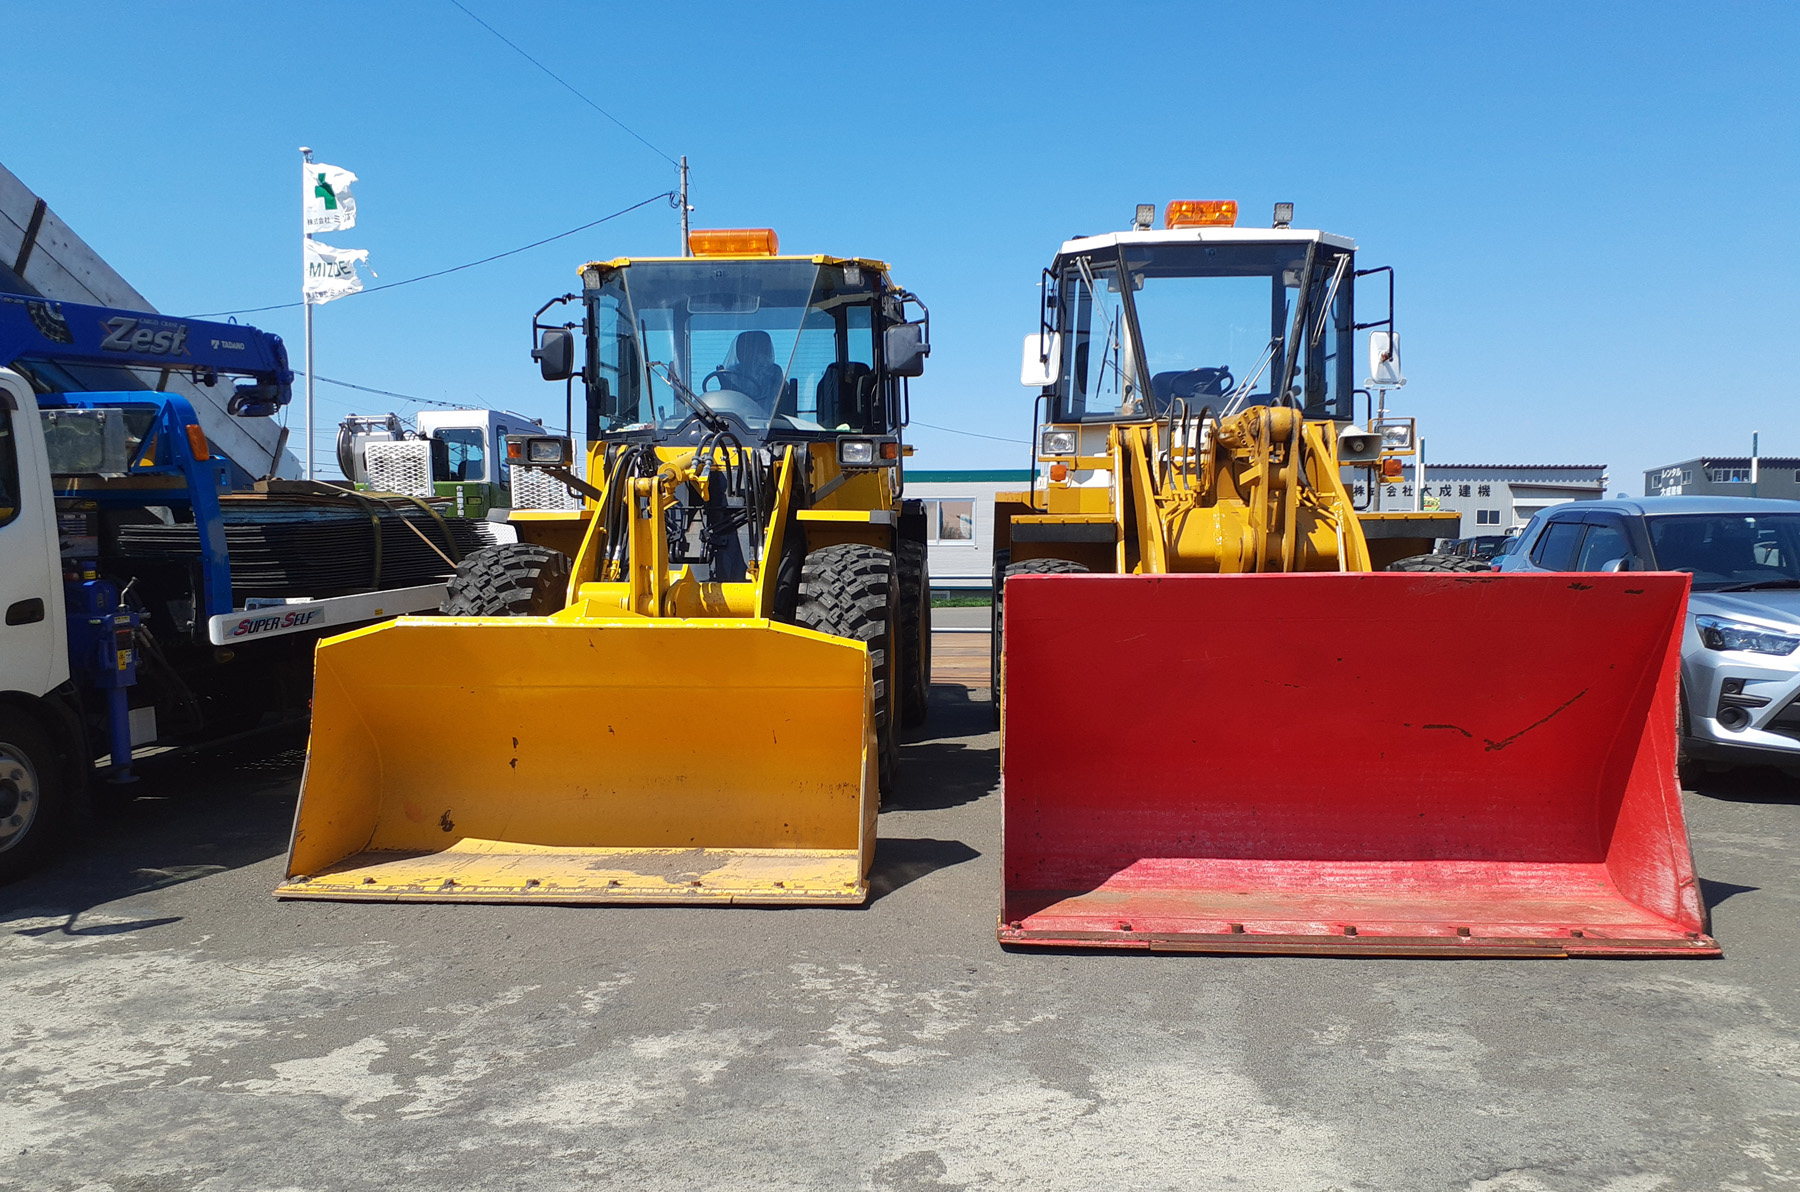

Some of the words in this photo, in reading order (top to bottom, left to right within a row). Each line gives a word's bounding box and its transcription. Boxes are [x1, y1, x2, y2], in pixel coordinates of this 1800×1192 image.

[309, 260, 352, 278] MIZOE
[101, 316, 187, 355] Zest
[221, 340, 245, 350] TADANO
[1661, 467, 1682, 478] レンタル
[234, 618, 281, 636] SUPER
[281, 611, 316, 628] SELF
